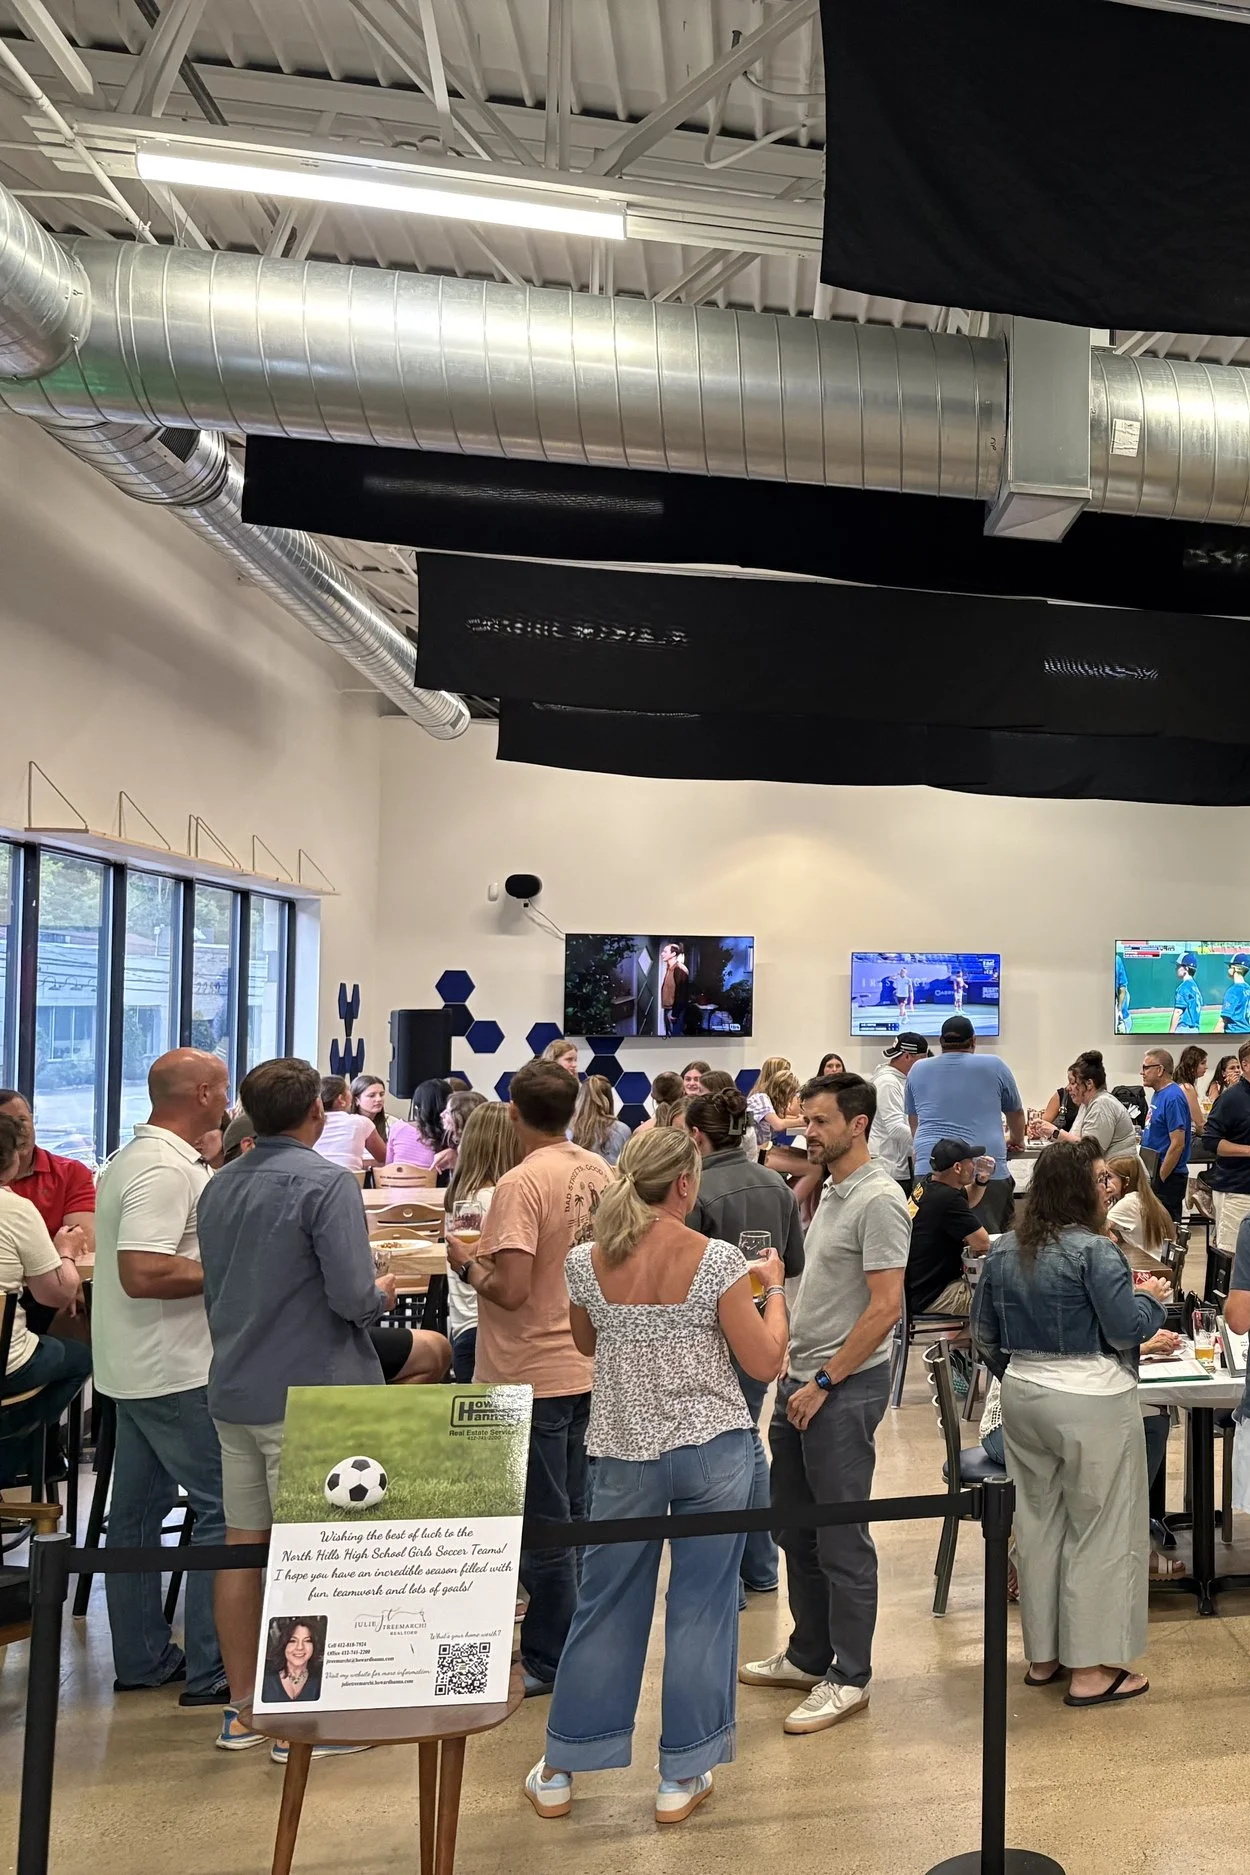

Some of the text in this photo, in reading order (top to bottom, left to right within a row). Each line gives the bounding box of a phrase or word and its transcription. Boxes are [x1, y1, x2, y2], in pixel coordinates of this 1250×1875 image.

[320, 1526, 474, 1544] Wishing the best of luck to the
[282, 1542, 508, 1562] North Hills High School Girls Soccer Teams!
[274, 1568, 284, 1582] I
[284, 1569, 308, 1582] hope
[310, 1574, 329, 1582] you
[332, 1568, 356, 1579] have
[374, 1564, 424, 1577] incredible
[426, 1568, 458, 1576] season
[460, 1562, 489, 1576] filled
[490, 1561, 513, 1572] with
[332, 1584, 384, 1597] teamwork
[386, 1584, 408, 1595] and
[408, 1583, 426, 1594] lots
[429, 1582, 442, 1596] of
[442, 1580, 474, 1596] goals!
[430, 1632, 450, 1640] What's
[350, 1670, 371, 1678] website
[371, 1669, 380, 1678] for
[396, 1668, 430, 1676] information
